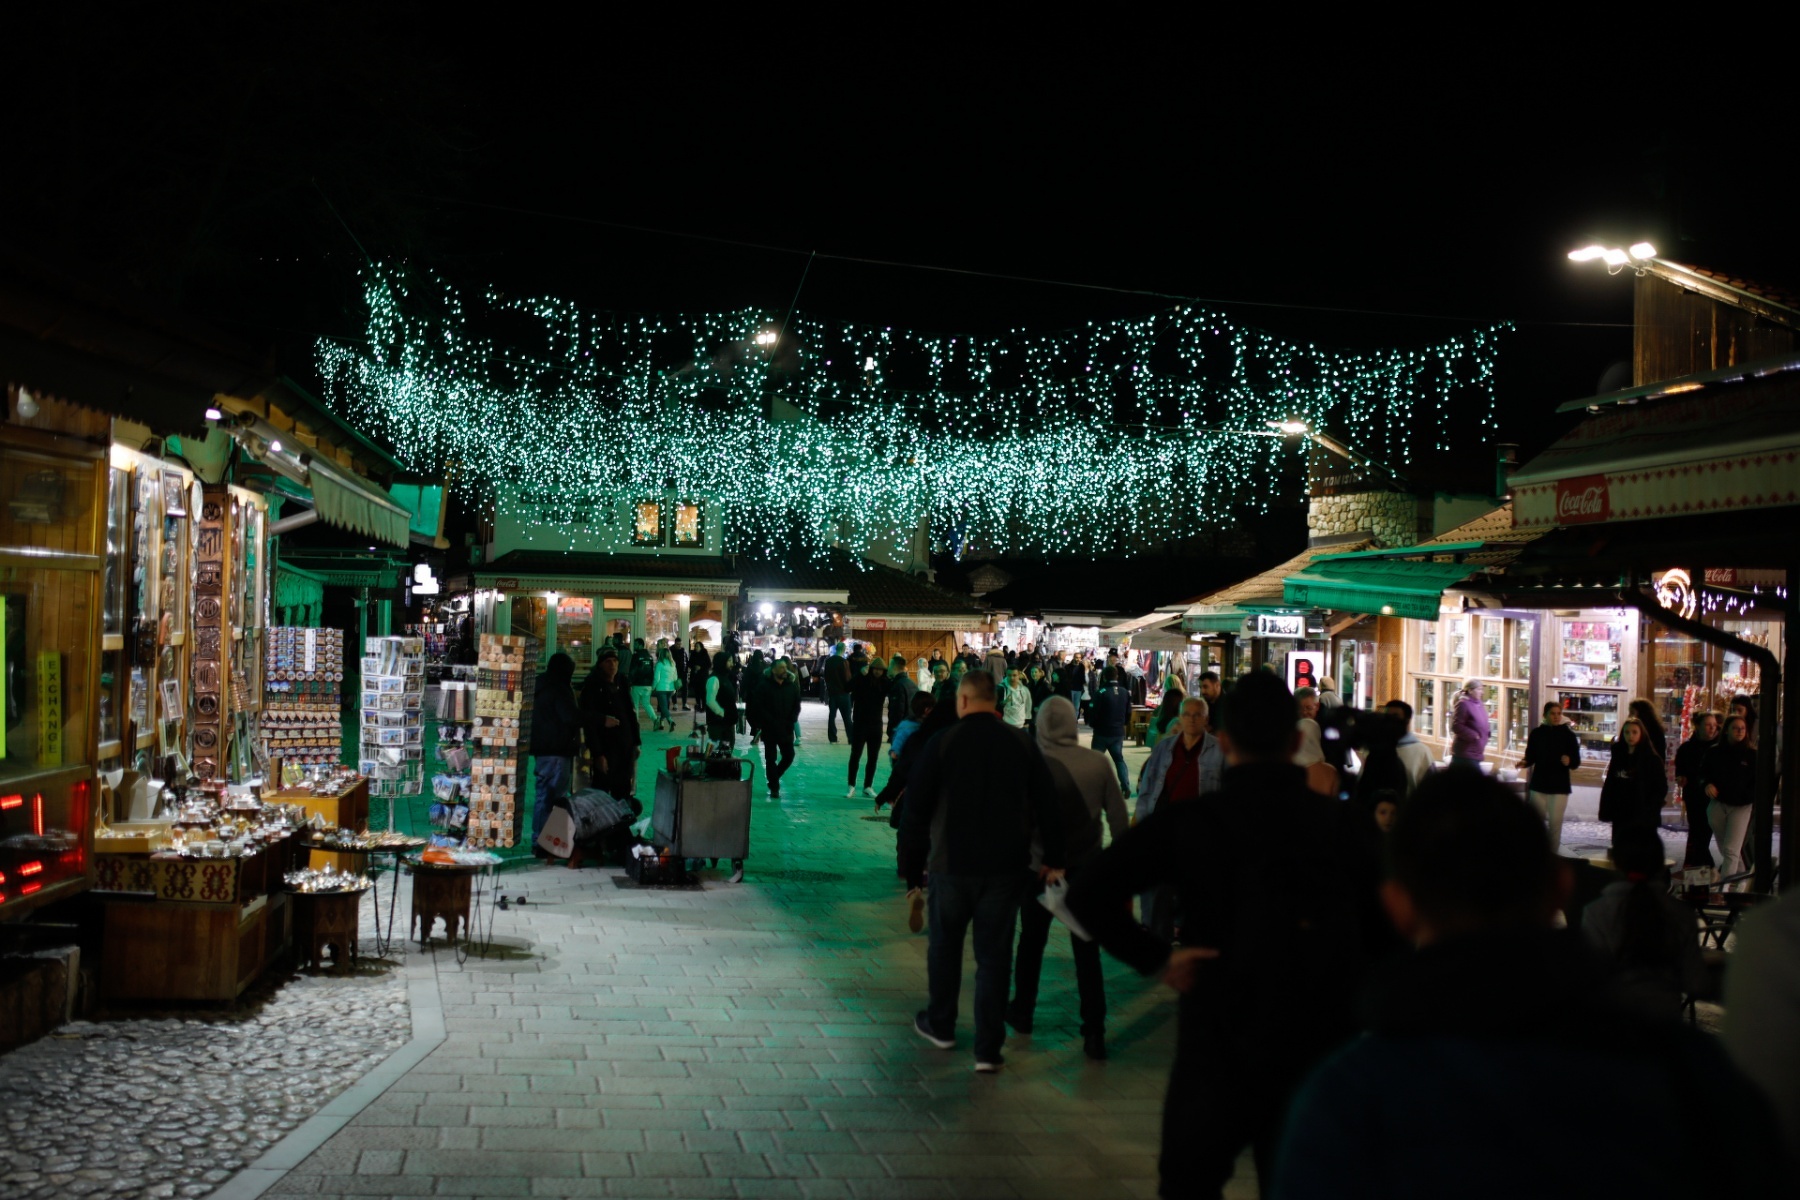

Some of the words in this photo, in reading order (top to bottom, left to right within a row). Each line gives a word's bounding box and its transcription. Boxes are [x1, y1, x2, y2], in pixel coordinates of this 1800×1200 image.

[1559, 486, 1606, 517] Coca-Cola
[605, 511, 615, 524] 2
[48, 661, 58, 754] EXCHANGE
